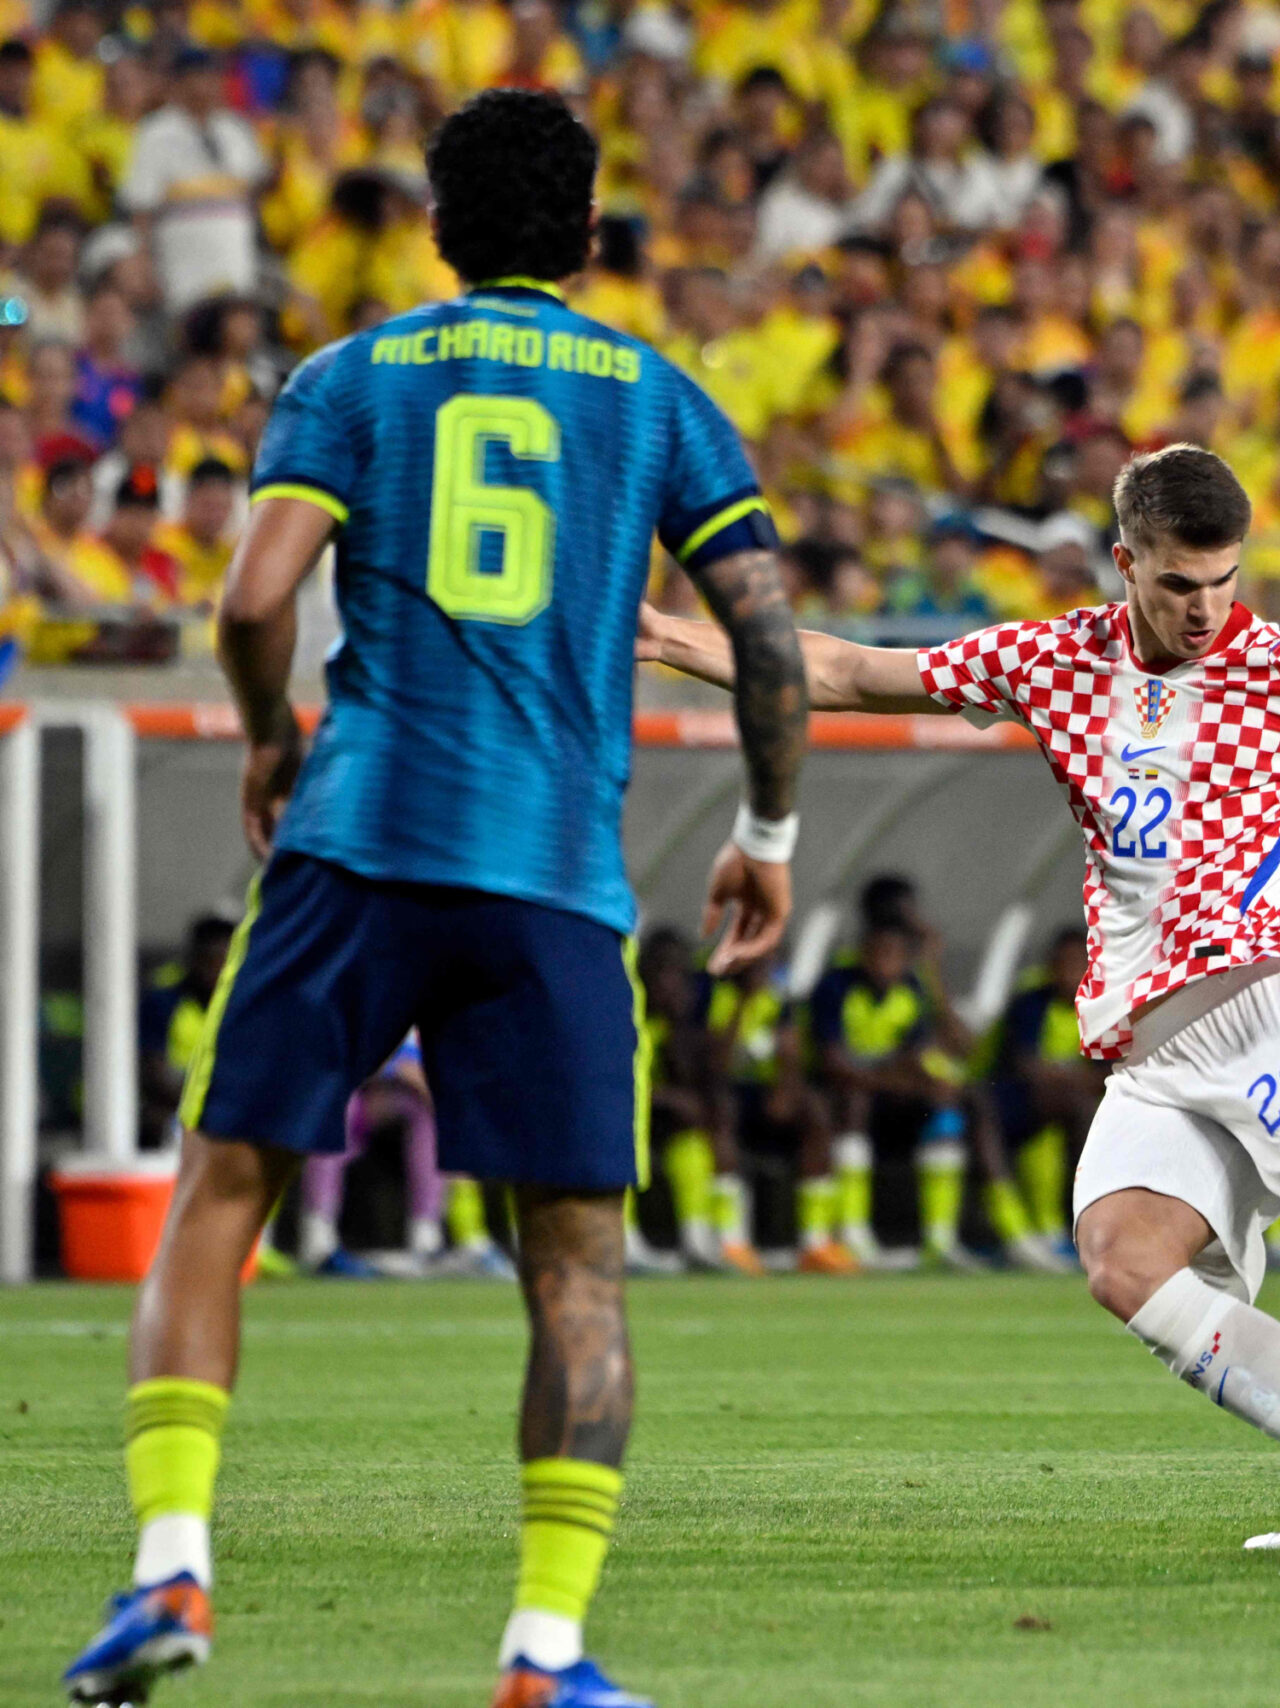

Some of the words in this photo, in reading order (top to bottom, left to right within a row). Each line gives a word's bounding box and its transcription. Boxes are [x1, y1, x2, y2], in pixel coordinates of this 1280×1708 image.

[371, 319, 543, 368] RICHARD
[547, 331, 642, 384] RIOS
[425, 392, 562, 627] 6
[1108, 786, 1173, 859] 22
